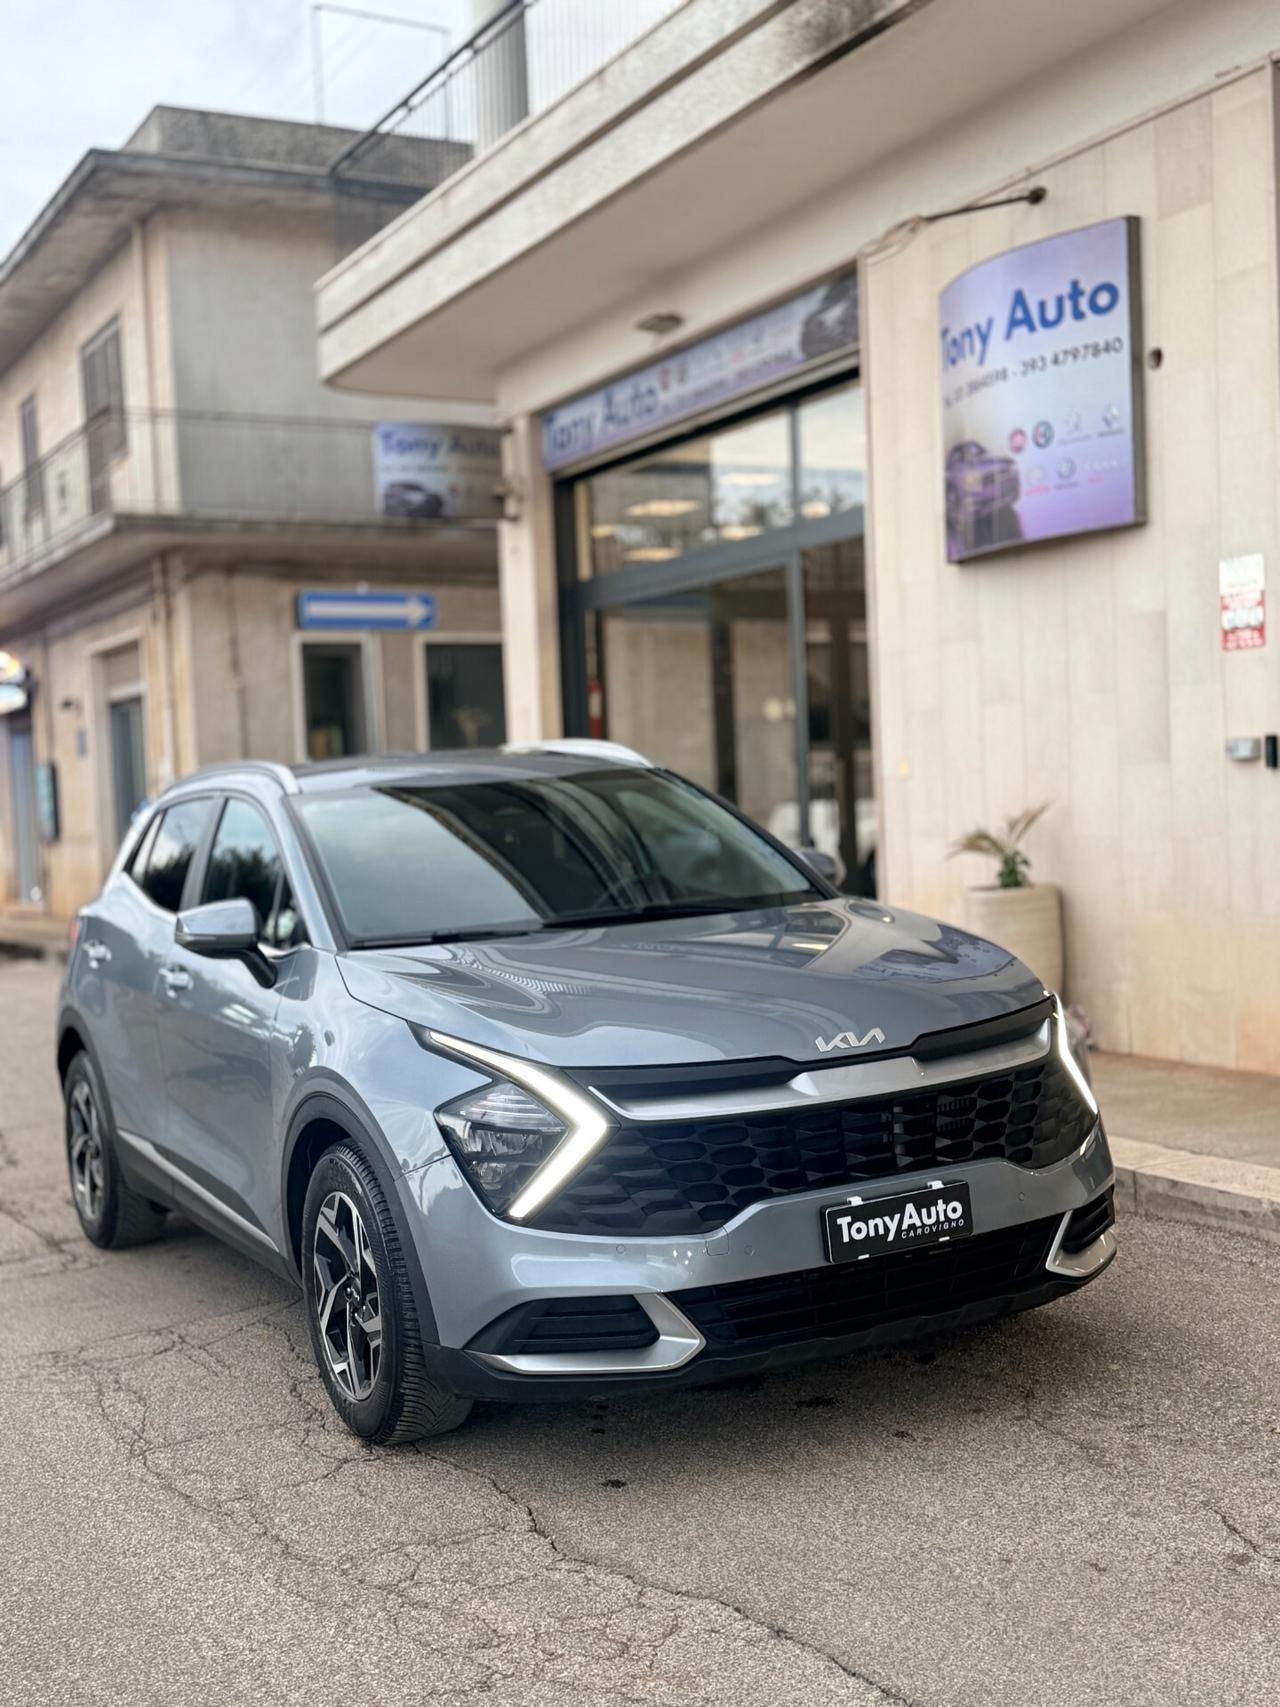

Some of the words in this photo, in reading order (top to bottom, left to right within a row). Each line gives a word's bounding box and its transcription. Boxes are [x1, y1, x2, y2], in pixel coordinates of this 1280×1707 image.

[941, 317, 994, 371] Tony
[1005, 279, 1120, 341] Auto
[1051, 337, 1124, 366] 4797840
[543, 413, 595, 458] Tony
[602, 381, 657, 424] Auto
[381, 430, 440, 459] Tony
[815, 1028, 886, 1052] KIA
[901, 1219, 964, 1239] CAROVIGNO
